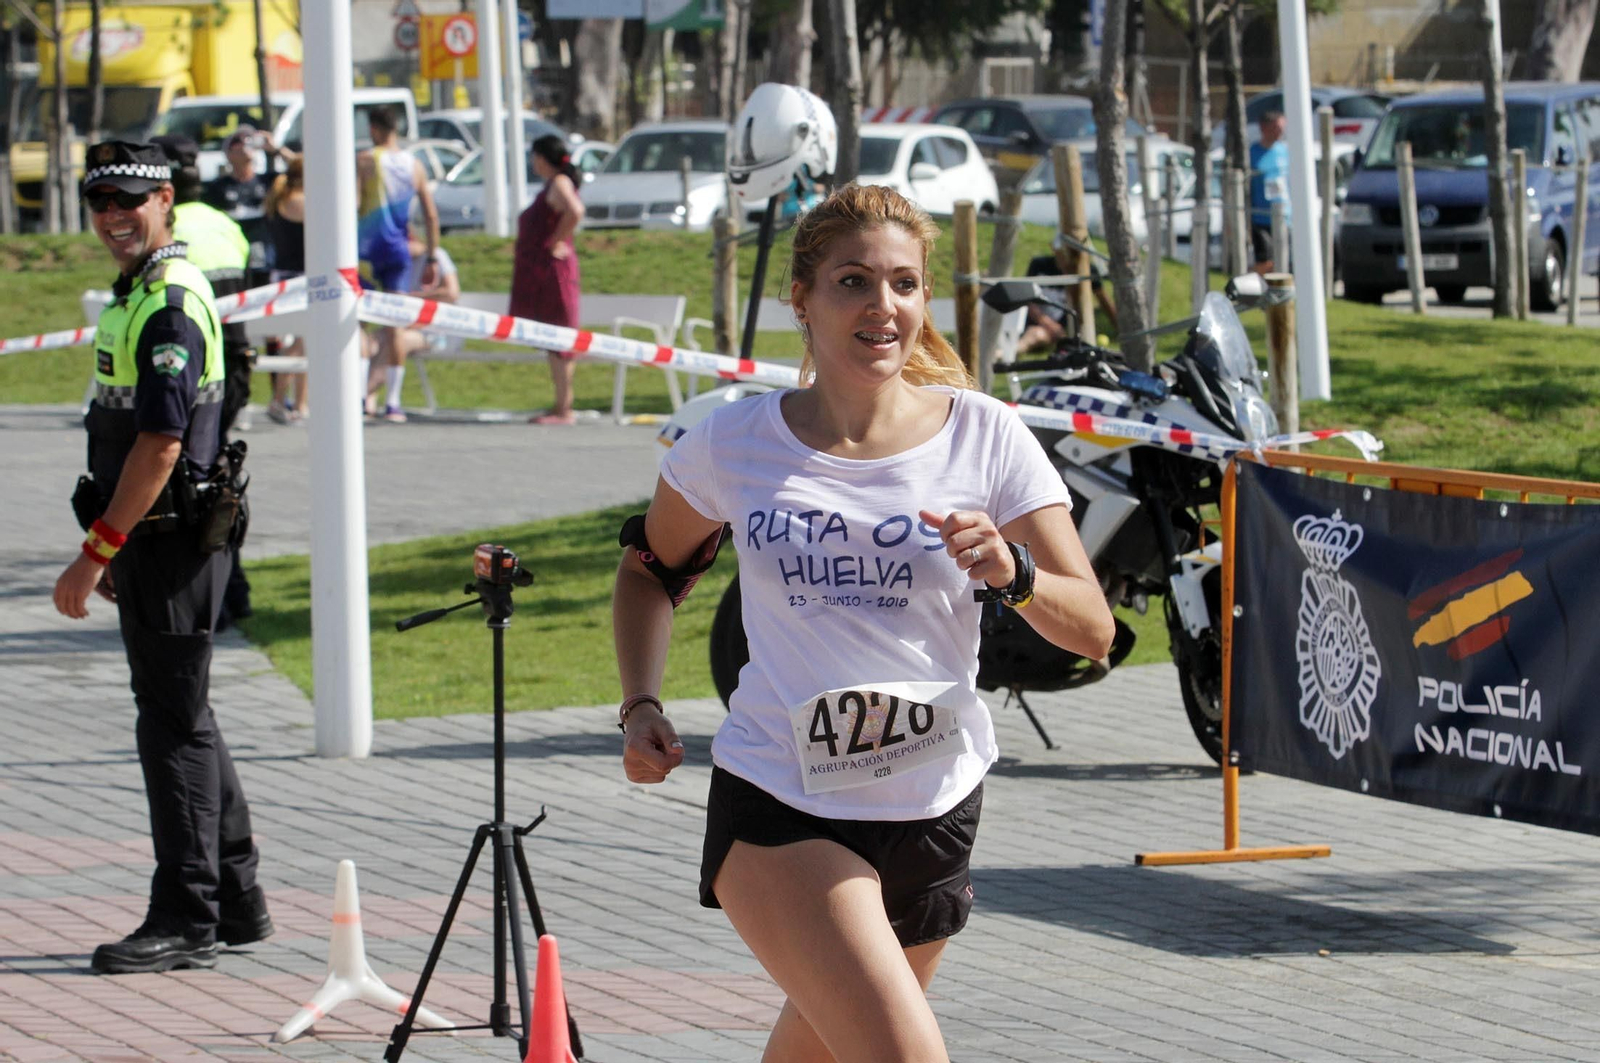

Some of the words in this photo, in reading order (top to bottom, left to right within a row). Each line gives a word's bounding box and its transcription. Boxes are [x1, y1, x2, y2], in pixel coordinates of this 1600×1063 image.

[748, 509, 848, 550] RUTA
[779, 555, 913, 589] HUELVA
[822, 595, 861, 607] JUNIO
[878, 597, 909, 608] 2018
[1417, 676, 1541, 722] POLICÍA
[809, 752, 884, 775] AGRUPACIÓN
[887, 733, 946, 761] DEPORTIVA
[1414, 723, 1581, 775] NACIONAL
[873, 766, 892, 778] 4228
